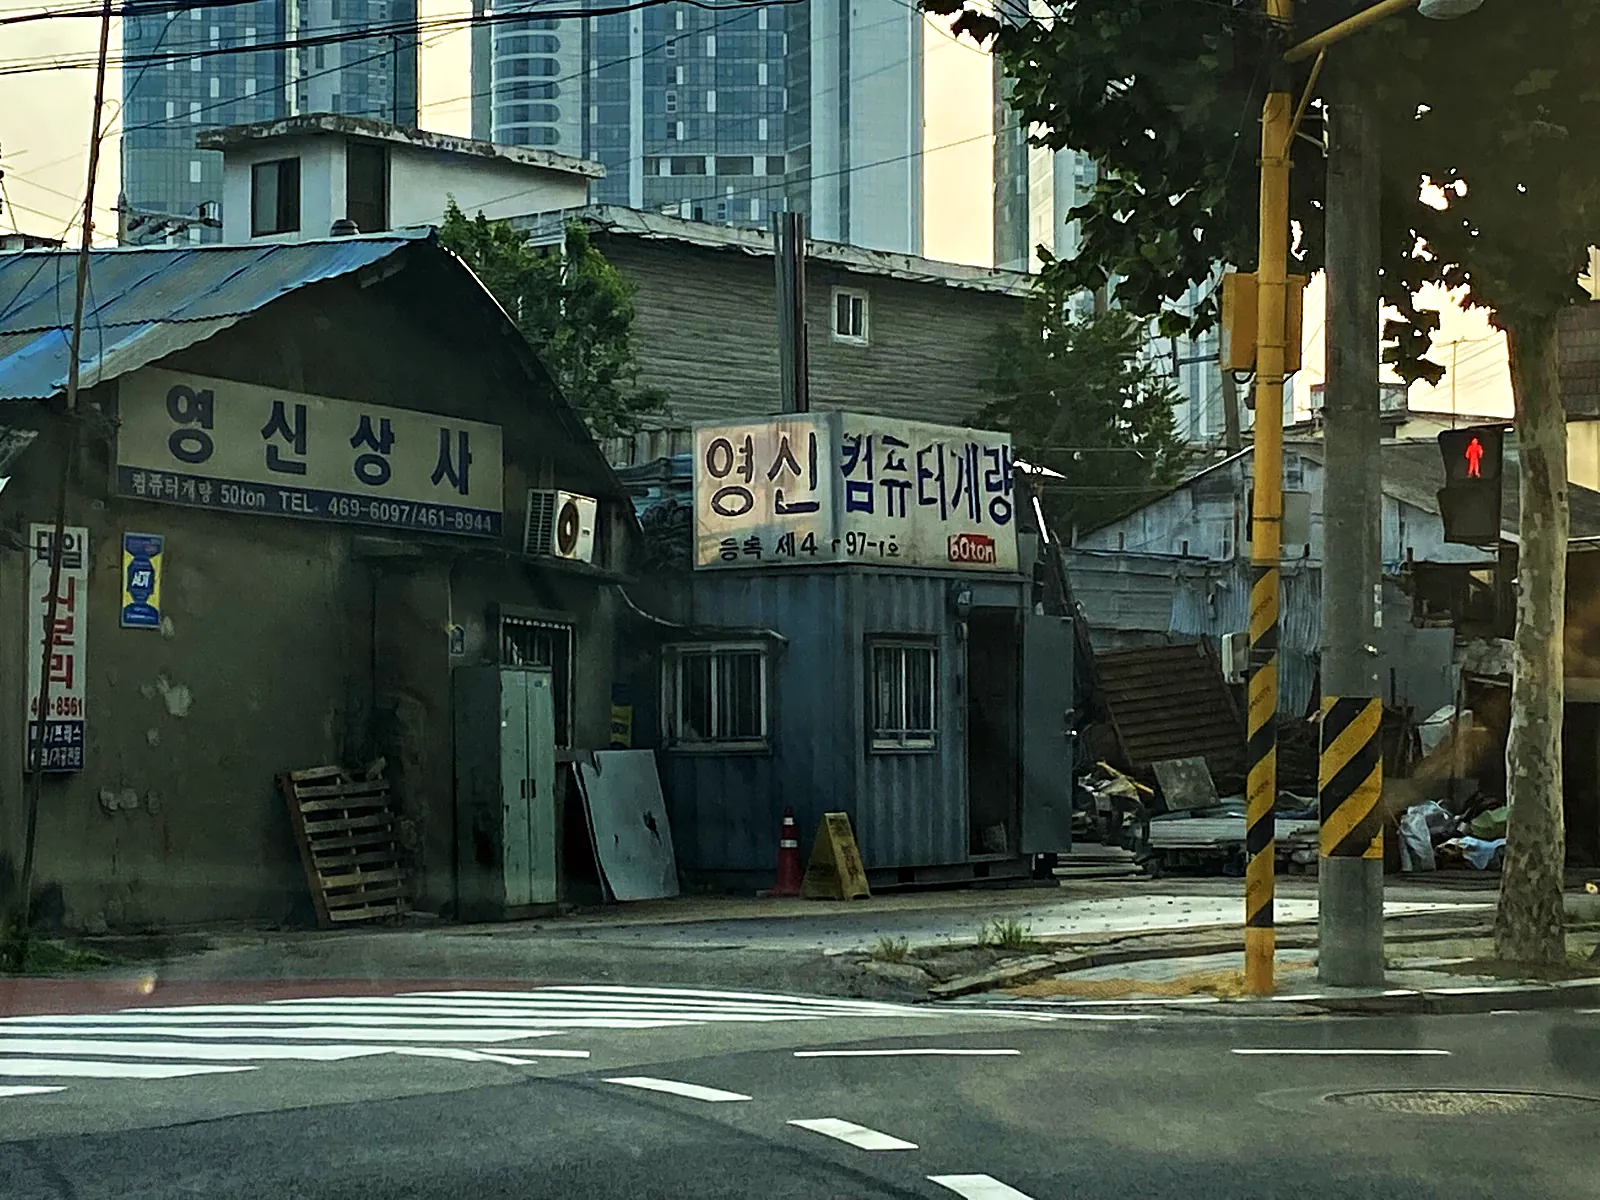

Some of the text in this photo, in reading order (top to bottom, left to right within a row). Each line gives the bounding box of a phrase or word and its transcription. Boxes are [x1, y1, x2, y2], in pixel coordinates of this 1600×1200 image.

[166, 384, 472, 495] 영신상사
[705, 432, 820, 517] 영신
[840, 431, 1013, 525] 컴퓨터계량
[220, 484, 265, 507] 50ton
[327, 496, 492, 532] 469-6097/461-8944
[31, 695, 83, 717] 4-8561
